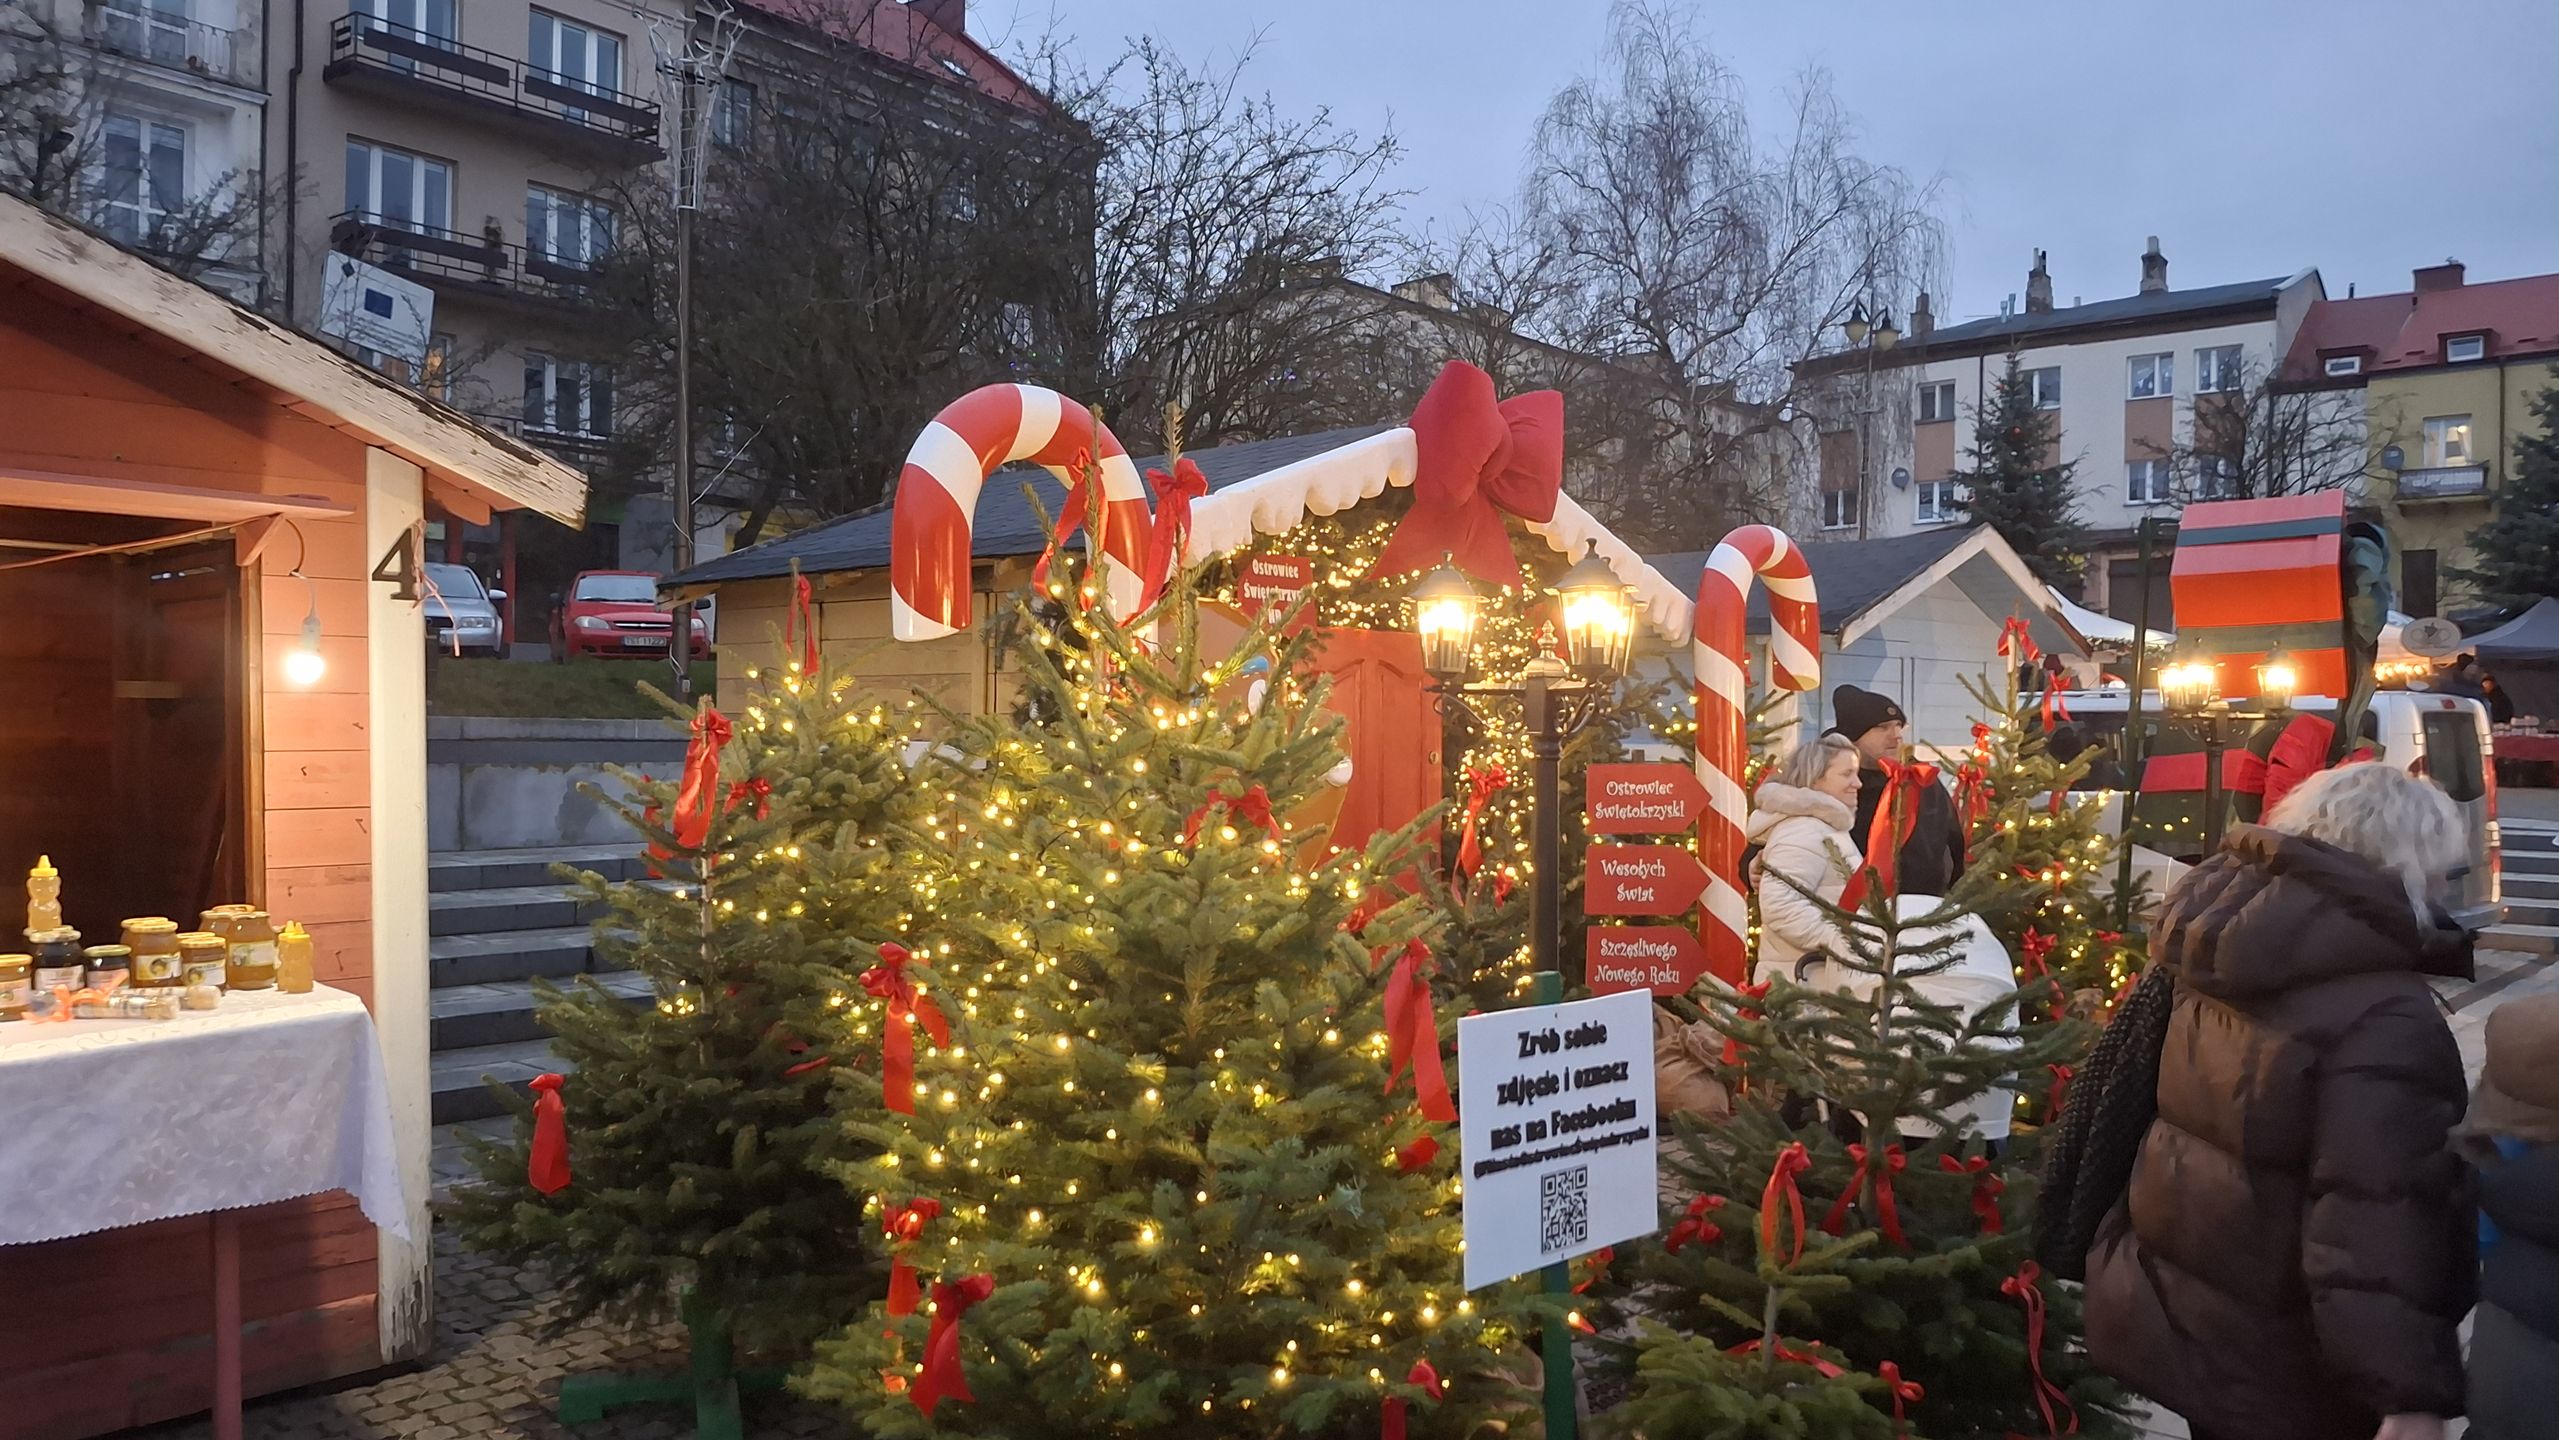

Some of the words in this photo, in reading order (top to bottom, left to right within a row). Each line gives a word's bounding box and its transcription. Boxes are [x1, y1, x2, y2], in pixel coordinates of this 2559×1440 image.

[371, 527, 421, 600] 4
[1252, 558, 1299, 579] Ostrowiec
[1606, 779, 1674, 797] Ostrowiec
[1600, 858, 1666, 880] Wesołych
[1594, 964, 1646, 987] Nowego
[1649, 964, 1680, 986] Roku
[1517, 1027, 1561, 1059] Zrób
[1563, 1019, 1608, 1051] sobie
[1496, 1069, 1560, 1107] zdjęcie
[1563, 1066, 1571, 1093] i
[1573, 1061, 1629, 1090] oznacz
[1490, 1123, 1522, 1152] nas
[1525, 1118, 1548, 1144] na
[1550, 1097, 1637, 1138] Facebooku
